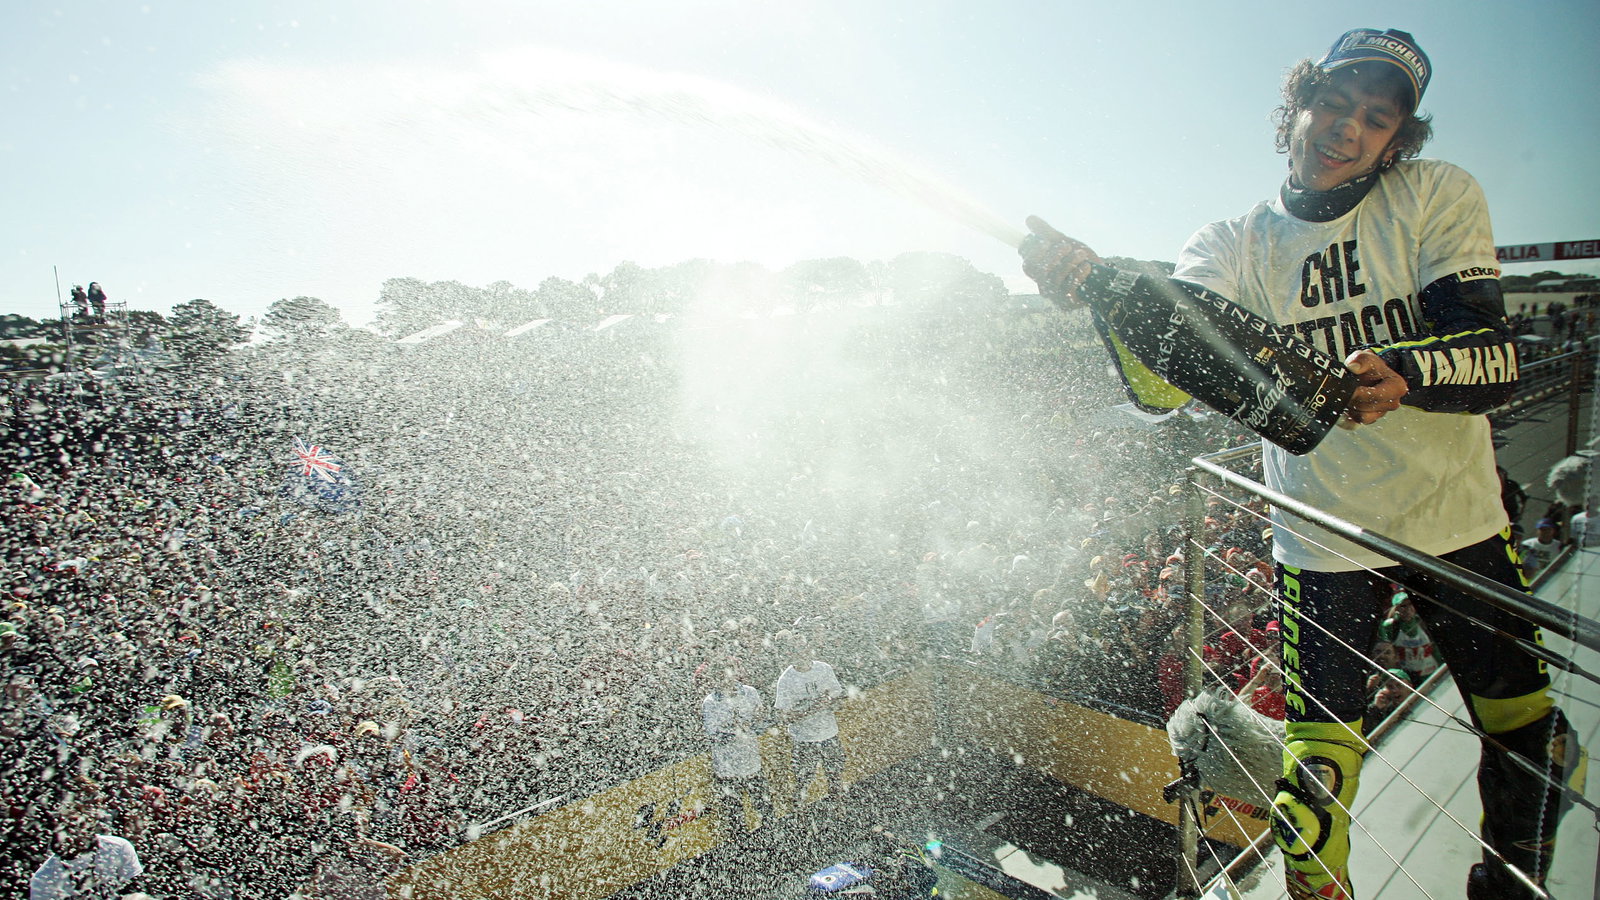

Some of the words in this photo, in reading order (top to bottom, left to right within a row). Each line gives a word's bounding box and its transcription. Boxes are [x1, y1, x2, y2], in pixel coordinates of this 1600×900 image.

[1366, 36, 1425, 77] MICHELIN
[1301, 240, 1366, 308] CHE
[1194, 290, 1347, 379] FREIXENET
[1411, 342, 1519, 387] YAMAHA
[1294, 394, 1326, 431] NEGRO
